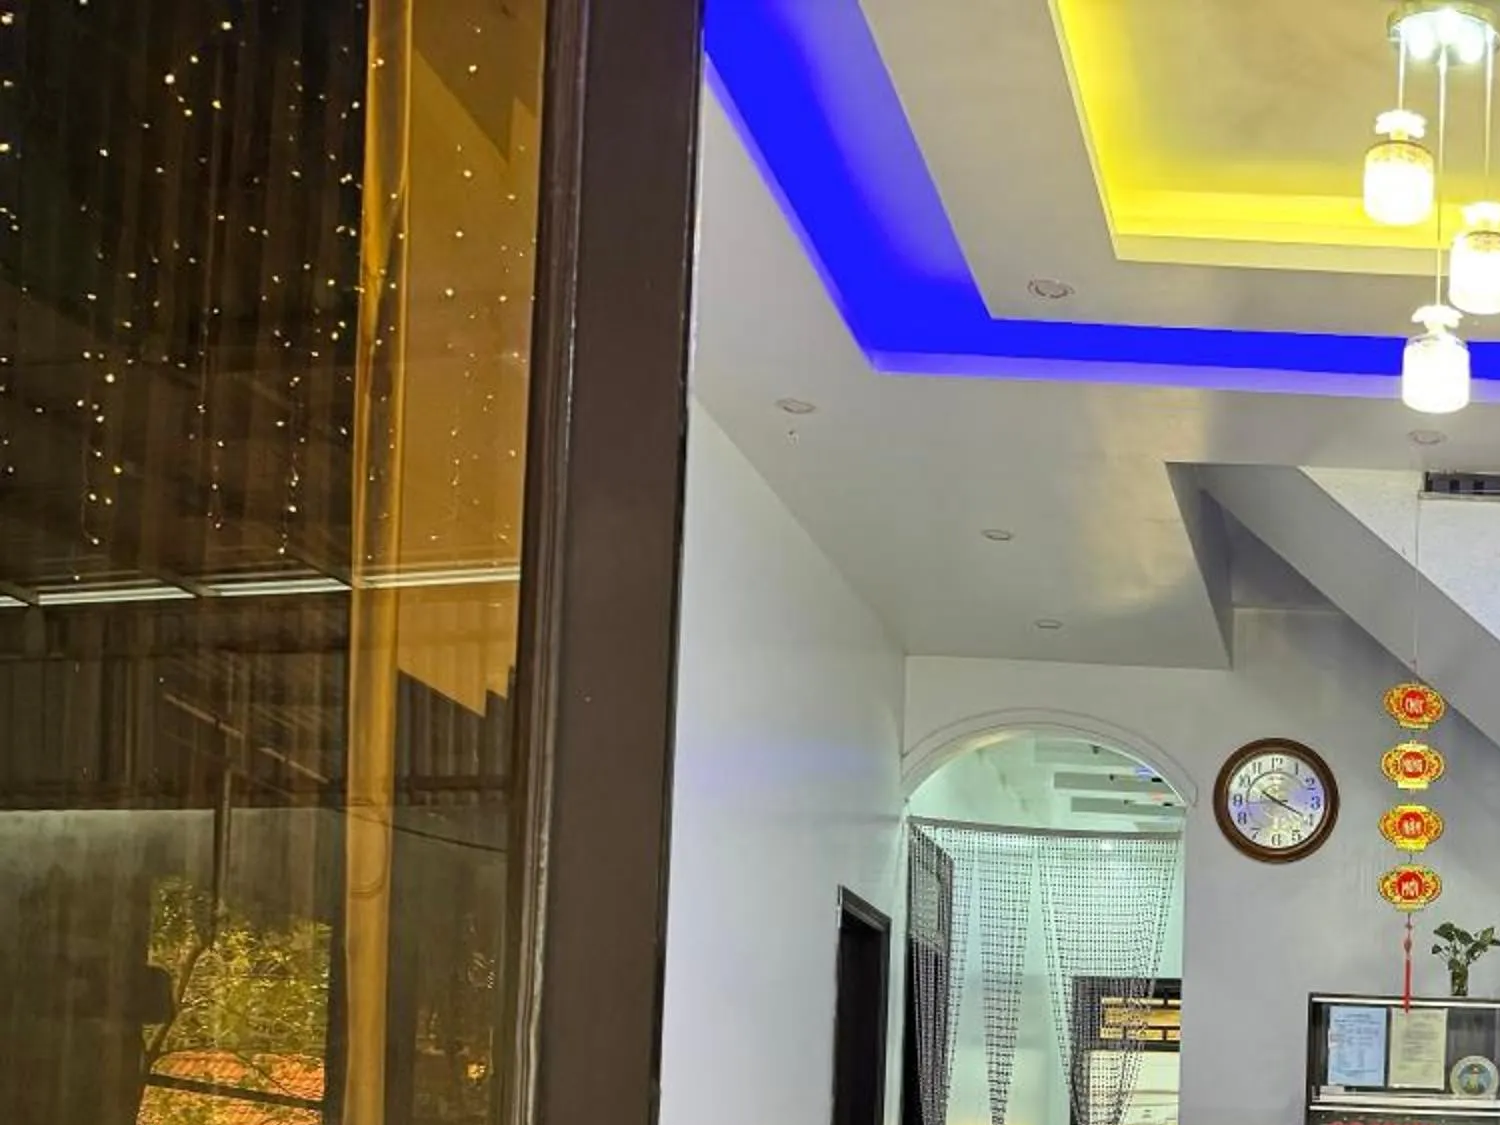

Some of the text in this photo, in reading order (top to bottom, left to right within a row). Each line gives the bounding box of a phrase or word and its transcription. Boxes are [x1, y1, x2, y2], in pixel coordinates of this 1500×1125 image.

[1306, 777, 1316, 790] 2
[1311, 796, 1321, 809] 3
[1250, 827, 1261, 840] 7
